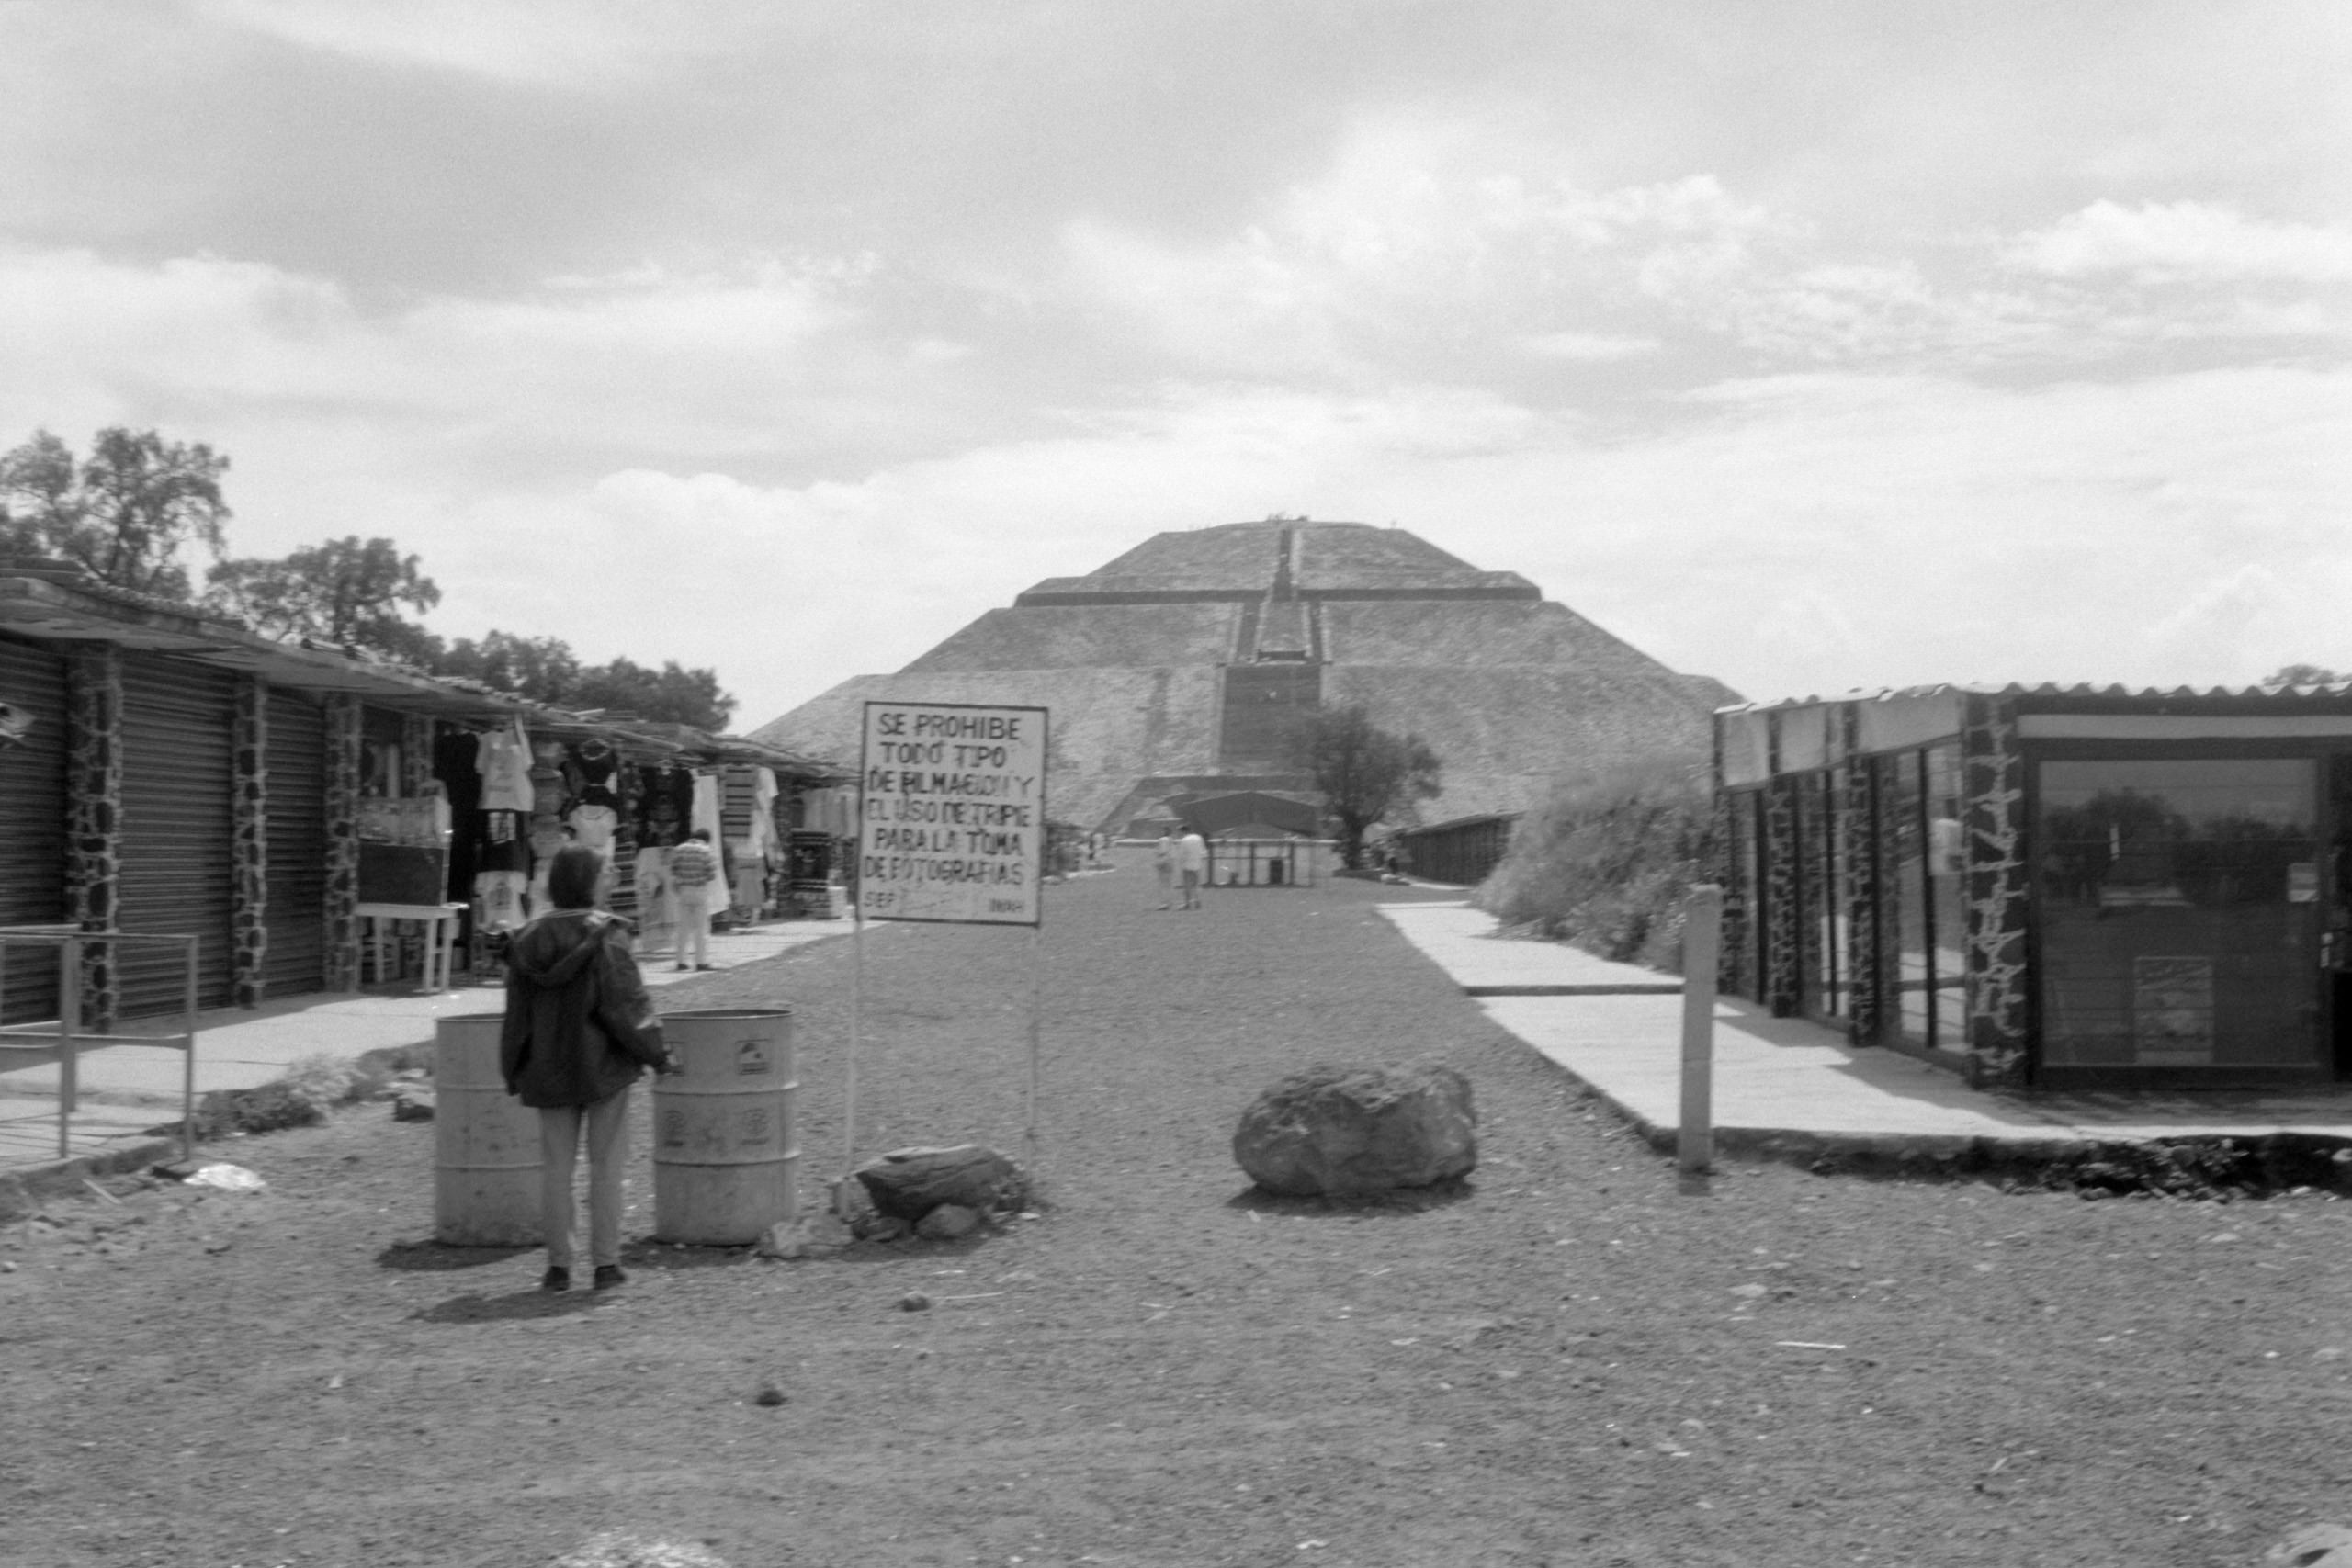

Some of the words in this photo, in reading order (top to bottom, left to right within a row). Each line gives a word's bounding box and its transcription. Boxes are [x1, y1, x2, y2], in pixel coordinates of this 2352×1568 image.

[877, 713, 906, 736] SE
[915, 714, 1021, 739] PROHIBE
[879, 740, 944, 764] TODO
[954, 745, 1007, 768] TIPO
[868, 769, 896, 793] DE
[1014, 776, 1035, 797] Y
[867, 798, 890, 820] EL
[895, 799, 938, 823] USO
[874, 828, 928, 852] PARA
[966, 829, 1024, 856] TOMA
[864, 855, 887, 879] DE
